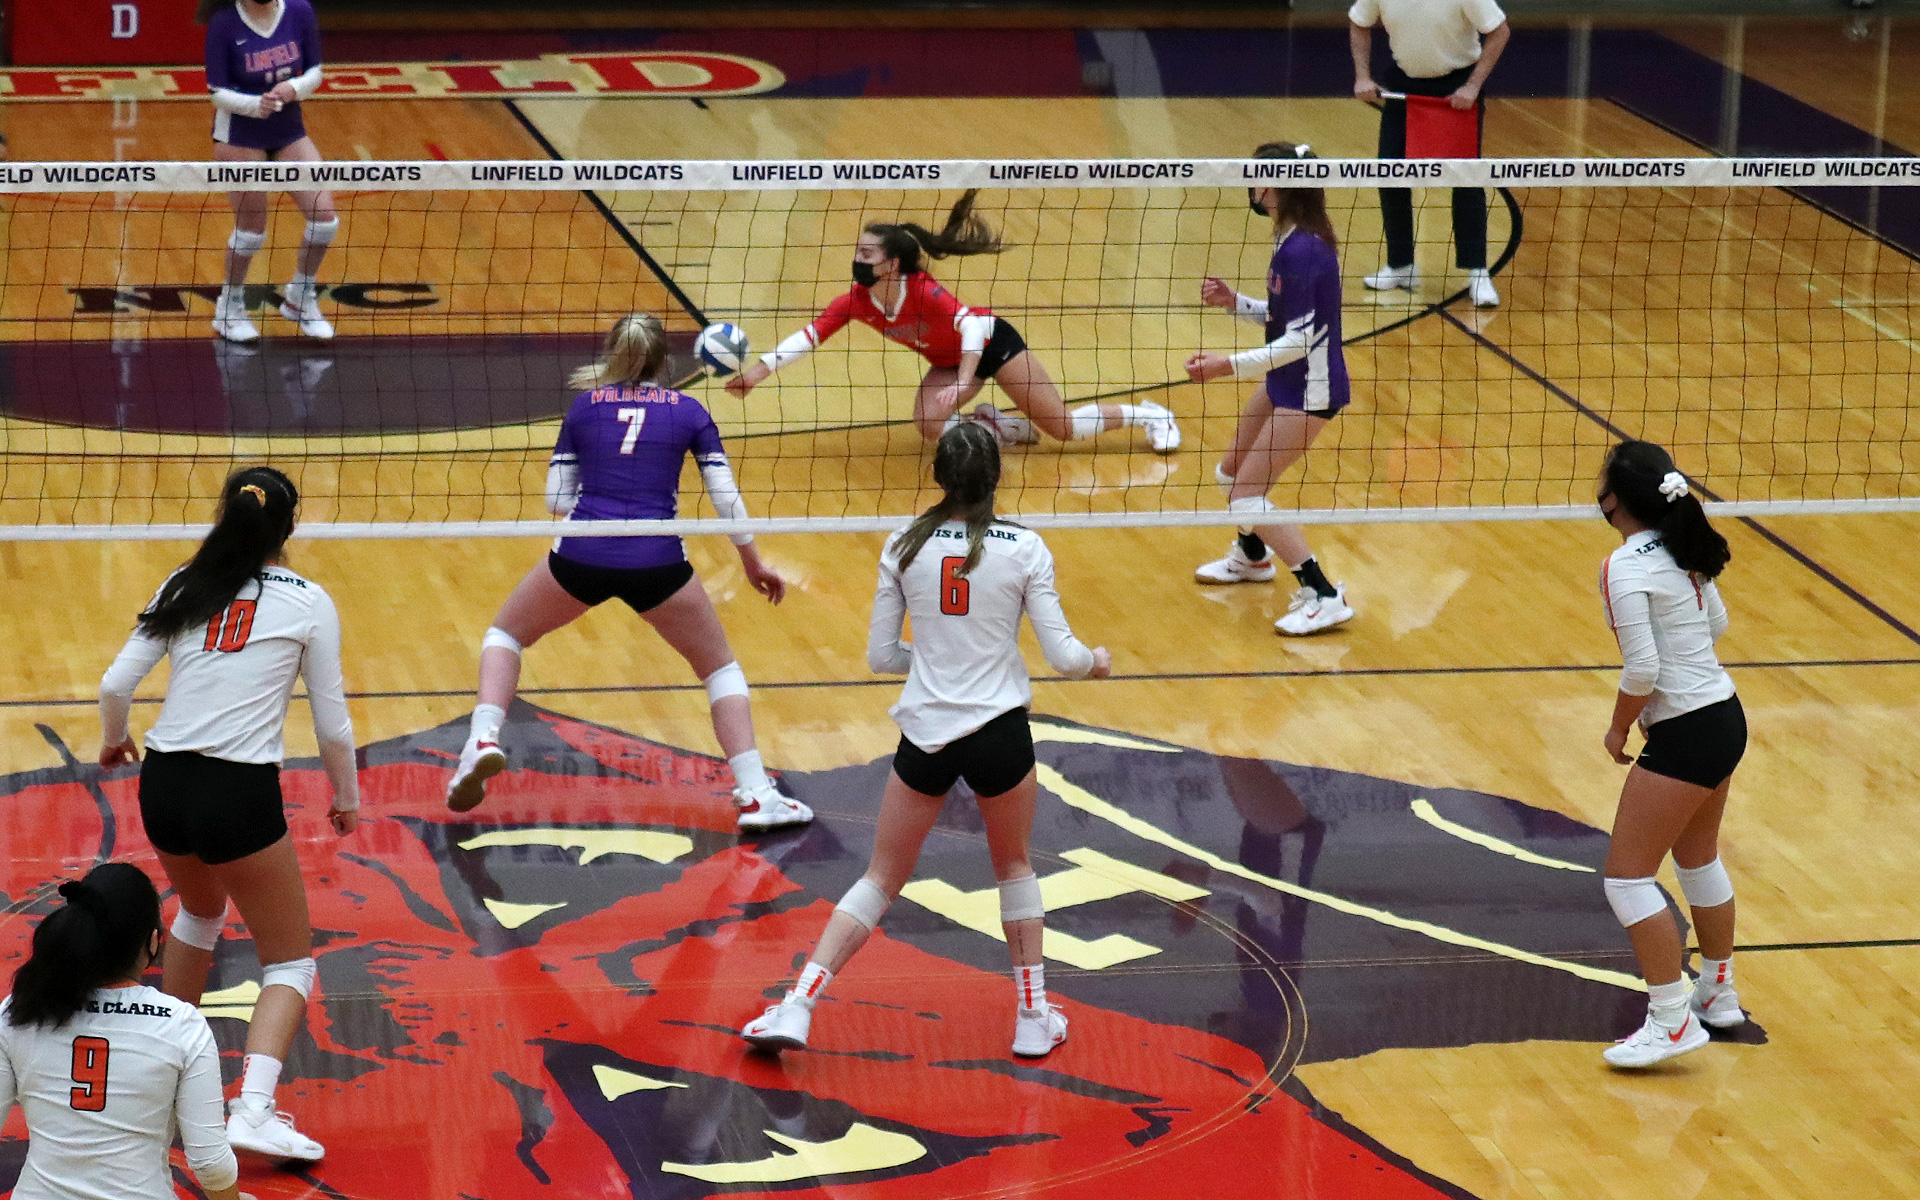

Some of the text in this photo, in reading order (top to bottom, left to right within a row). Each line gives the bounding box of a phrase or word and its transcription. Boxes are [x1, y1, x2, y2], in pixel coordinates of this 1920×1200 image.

[110, 3, 139, 39] D
[43, 166, 156, 183] WILDCATS
[207, 166, 420, 183] LINFIELD WILDCATS
[471, 165, 682, 181] LINFIELD WILDCATS
[732, 165, 939, 181] LINFIELD WILDCATS
[989, 164, 1193, 180] LINFIELD WILDCATS
[1242, 163, 1441, 179] LINFIELD WILDCATS
[1490, 162, 1684, 178] LINFIELD WILDCATS
[1732, 162, 1920, 177] LINFIELD WILDCATS
[591, 387, 680, 404] WILDCATS
[616, 407, 646, 455] 7
[985, 529, 1018, 542] ARK
[261, 572, 307, 589] LARK
[940, 556, 970, 616] 6
[203, 599, 258, 653] 10
[102, 1002, 172, 1018] CLARK
[69, 1035, 110, 1112] 9
